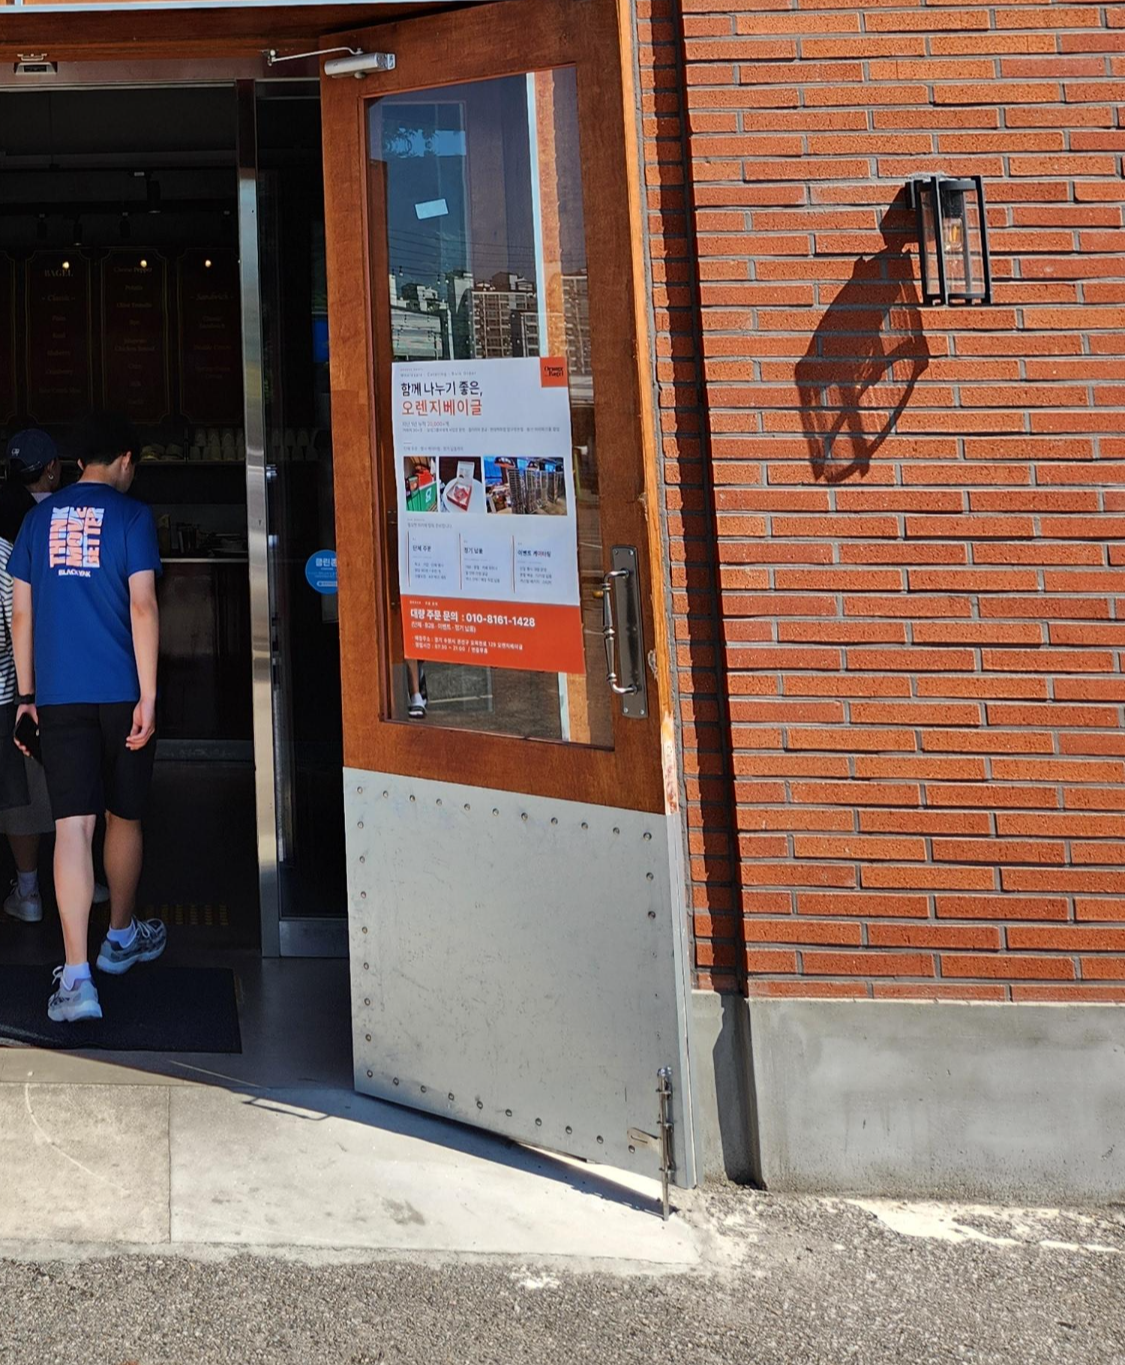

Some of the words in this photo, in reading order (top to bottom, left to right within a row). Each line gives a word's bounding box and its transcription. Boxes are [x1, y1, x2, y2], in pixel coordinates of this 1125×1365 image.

[401, 382, 422, 397] 함께
[424, 380, 456, 396] 나누기
[459, 380, 483, 397] 좋은,
[49, 506, 70, 568] THINK
[66, 506, 87, 567] MOVE
[410, 608, 425, 620] 대량
[427, 609, 441, 621] 주문
[443, 610, 458, 622] 문의
[466, 613, 535, 627] 010-8161-1428
